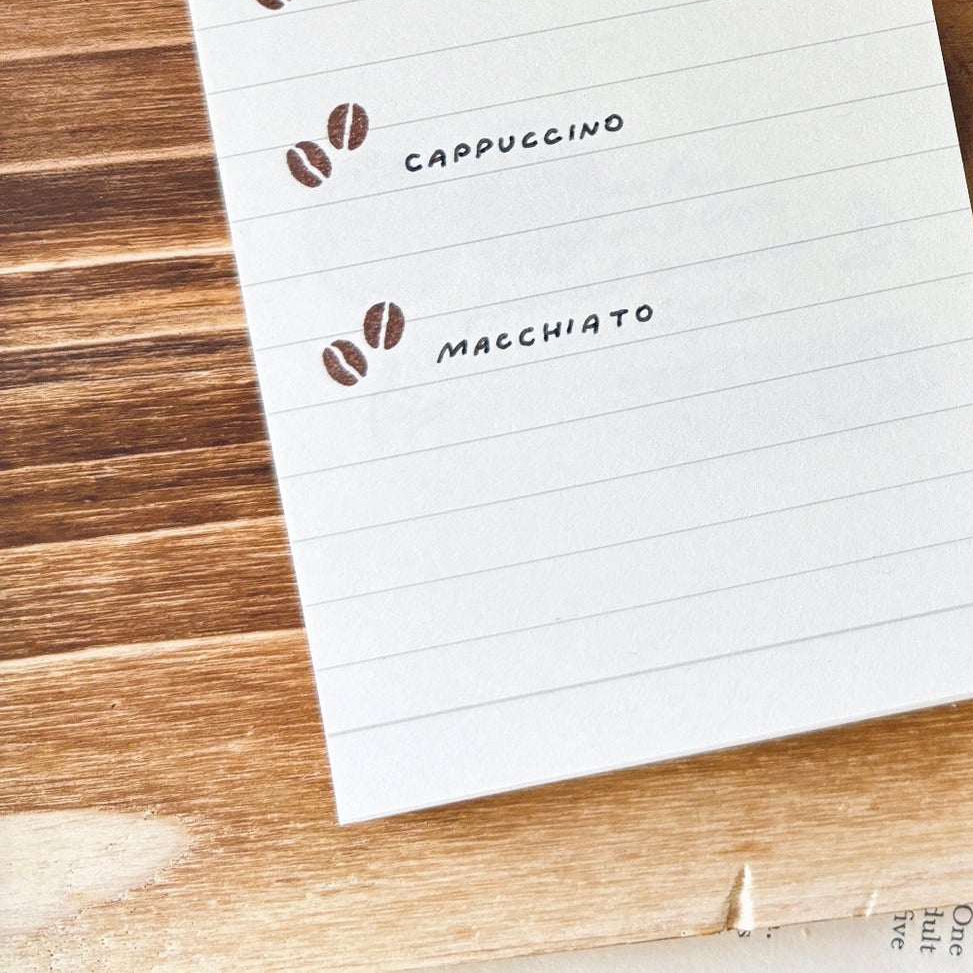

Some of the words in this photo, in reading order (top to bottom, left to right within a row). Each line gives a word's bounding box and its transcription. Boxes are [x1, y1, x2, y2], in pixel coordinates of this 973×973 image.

[404, 114, 624, 173] CAPPUCCINO
[436, 304, 654, 364] MACCHIATO
[949, 904, 973, 957] One
